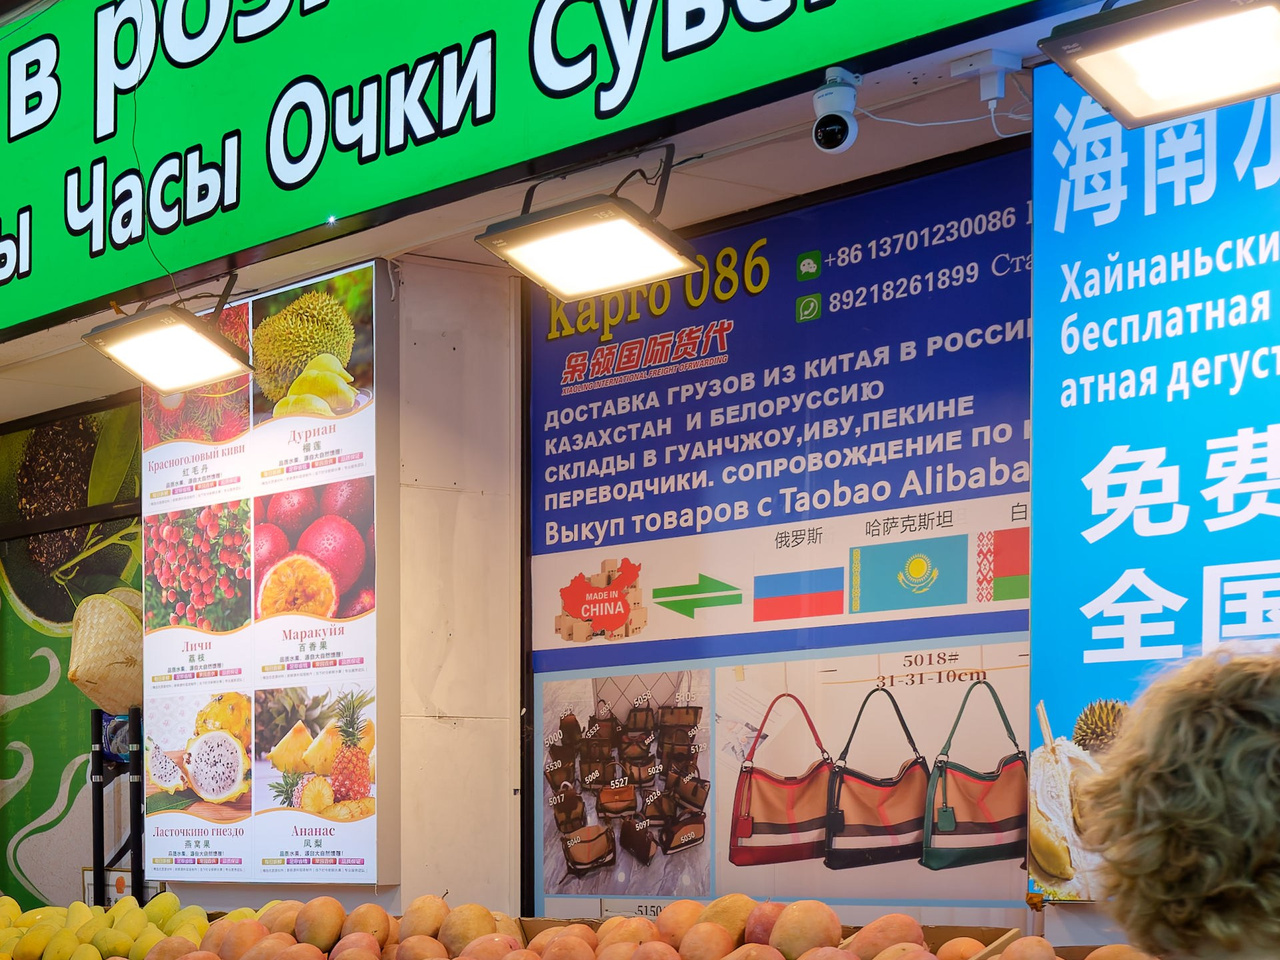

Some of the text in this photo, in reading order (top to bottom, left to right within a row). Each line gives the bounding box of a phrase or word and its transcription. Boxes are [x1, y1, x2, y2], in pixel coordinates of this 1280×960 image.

[8, 35, 61, 143] в
[94, 0, 330, 144] ро
[64, 128, 241, 258] Часы
[267, 30, 498, 192] Очки
[530, 0, 838, 118] Сув
[824, 207, 1017, 267] +86 13701230086
[685, 237, 771, 310] 086
[828, 262, 980, 314] 89218261899
[1060, 290, 1271, 356] бесплатная
[561, 354, 728, 397] XIAOLING INTERNATIONAL FREIGHT OFRWARDING
[544, 394, 660, 431] ДОСТАВКА
[667, 372, 756, 406] ГРУЗОВ
[763, 363, 797, 386] ИЗ
[804, 346, 890, 382] КИТАЯ
[899, 340, 917, 361] В
[1060, 365, 1158, 409] атная
[544, 380, 885, 456] КАЗАХСТАН И БЕЛОРУССИЮ
[288, 423, 337, 445] Дуриан
[148, 444, 245, 473] Красноголовый киви
[544, 455, 636, 485] СКЛАДЫ
[643, 447, 657, 468] В
[544, 422, 1013, 511] ПЕРЕВОДЧИКИ. СОПРОВОЖДЕНИЕ ПО
[182, 464, 208, 477] 红毛丹
[545, 459, 1031, 547] Выкуп товаров с Taobao Alibaba
[865, 510, 955, 538] 哈萨克斯坦
[774, 526, 825, 551] 俄罗斯
[586, 590, 619, 602] MADE IN
[581, 600, 625, 619] CHINA
[282, 623, 345, 642] Маракуйя
[181, 641, 212, 652] Личи
[298, 641, 328, 652] 百香果
[188, 654, 205, 663] 荔枝
[903, 651, 961, 669] 5018#
[876, 668, 988, 690] 31-31-10cm
[633, 691, 652, 708] 5058
[544, 730, 563, 747] 5000
[545, 760, 562, 773] 5530
[648, 765, 663, 776] 5029
[584, 769, 600, 785] 5008
[610, 777, 629, 790] 5527
[548, 793, 565, 807] 5017
[645, 790, 661, 806] 5026
[152, 827, 245, 838] Ласточкино гнездо
[291, 825, 336, 837] Ананас
[635, 819, 650, 832] 5097
[184, 839, 211, 849] 燕窝果
[303, 839, 323, 848] 凤梨
[567, 836, 581, 848] 5040
[680, 831, 696, 844] 5030
[637, 904, 666, 916] 5150
